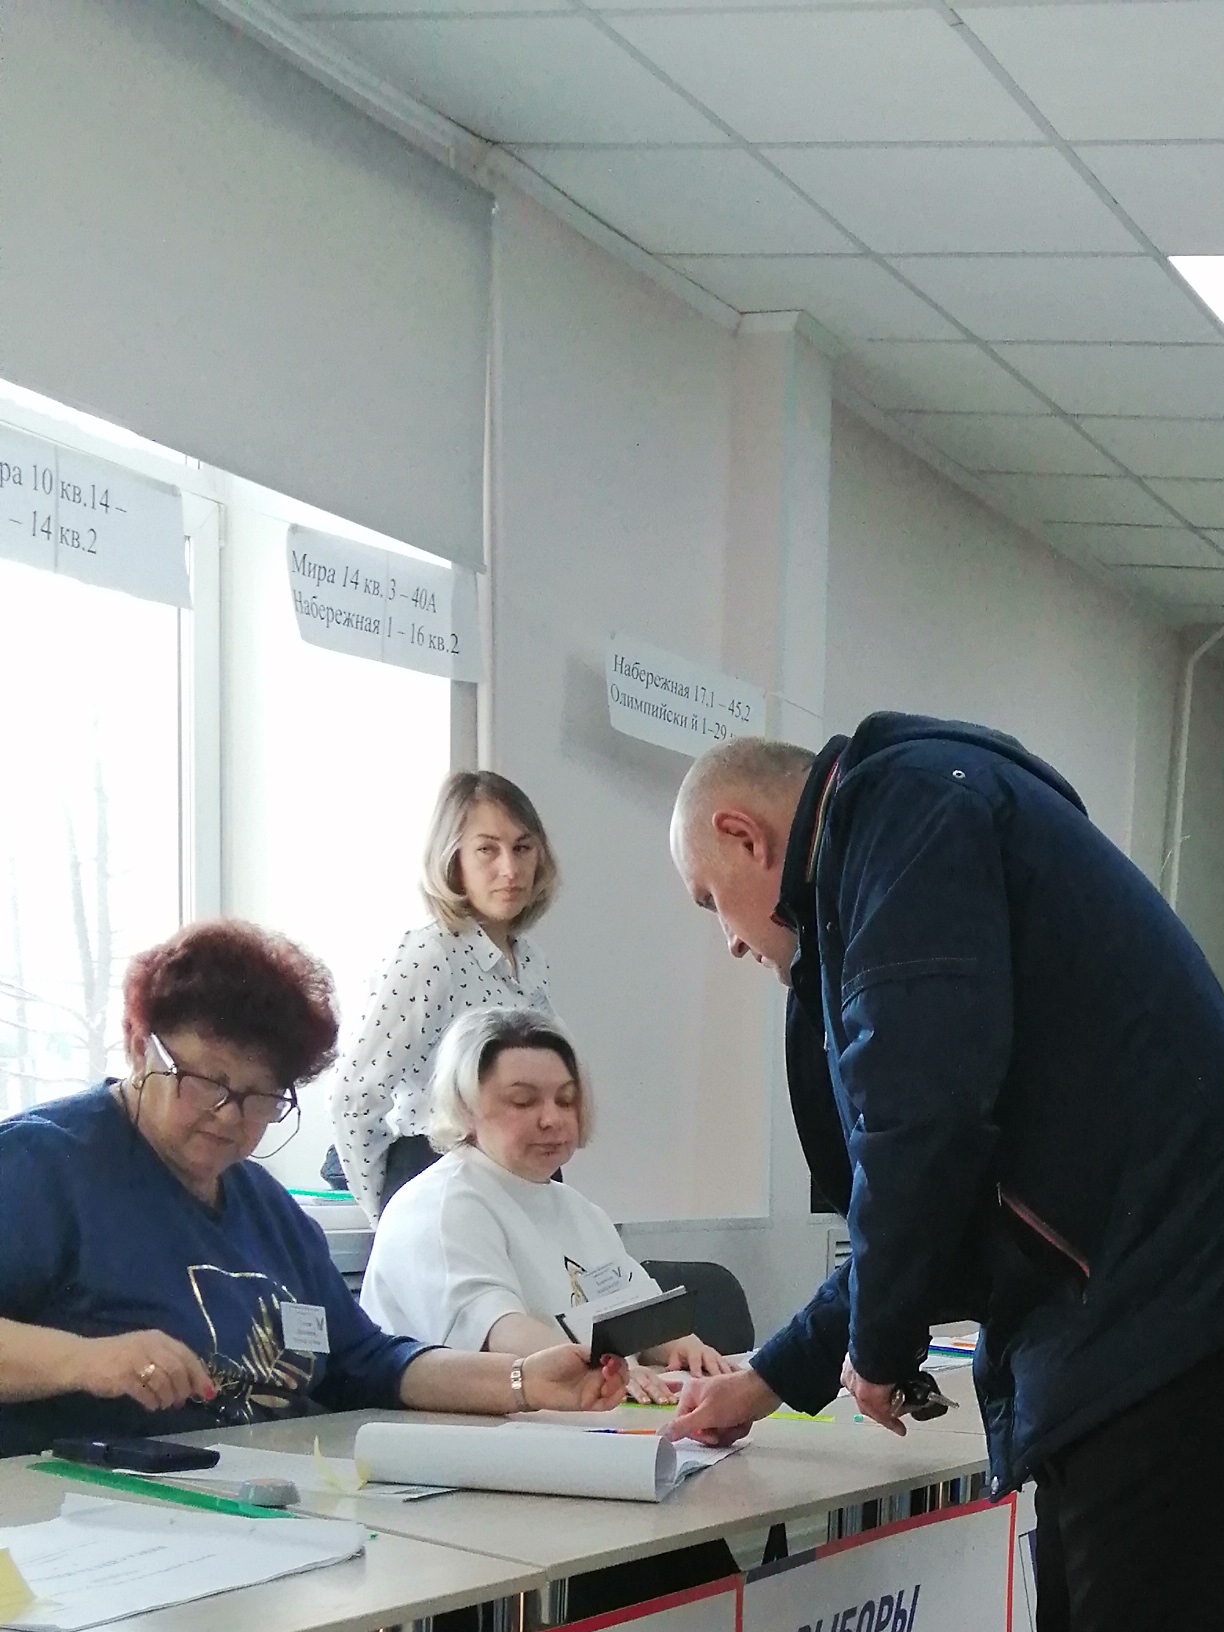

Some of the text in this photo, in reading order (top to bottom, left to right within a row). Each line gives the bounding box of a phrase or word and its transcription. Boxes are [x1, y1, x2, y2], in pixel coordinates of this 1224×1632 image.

[0, 462, 22, 488] ра
[33, 465, 53, 495] 10
[32, 510, 52, 540] 14
[59, 526, 97, 554] кв.2
[292, 550, 336, 587] Мира
[342, 566, 360, 590] 14
[364, 578, 383, 598] кв.
[388, 579, 396, 600] 3
[293, 590, 381, 635] Набережная
[387, 617, 392, 638] 1
[410, 623, 425, 647] 16
[613, 654, 690, 699] Набережная
[695, 685, 714, 708] 17,1
[728, 699, 751, 722] 45,2
